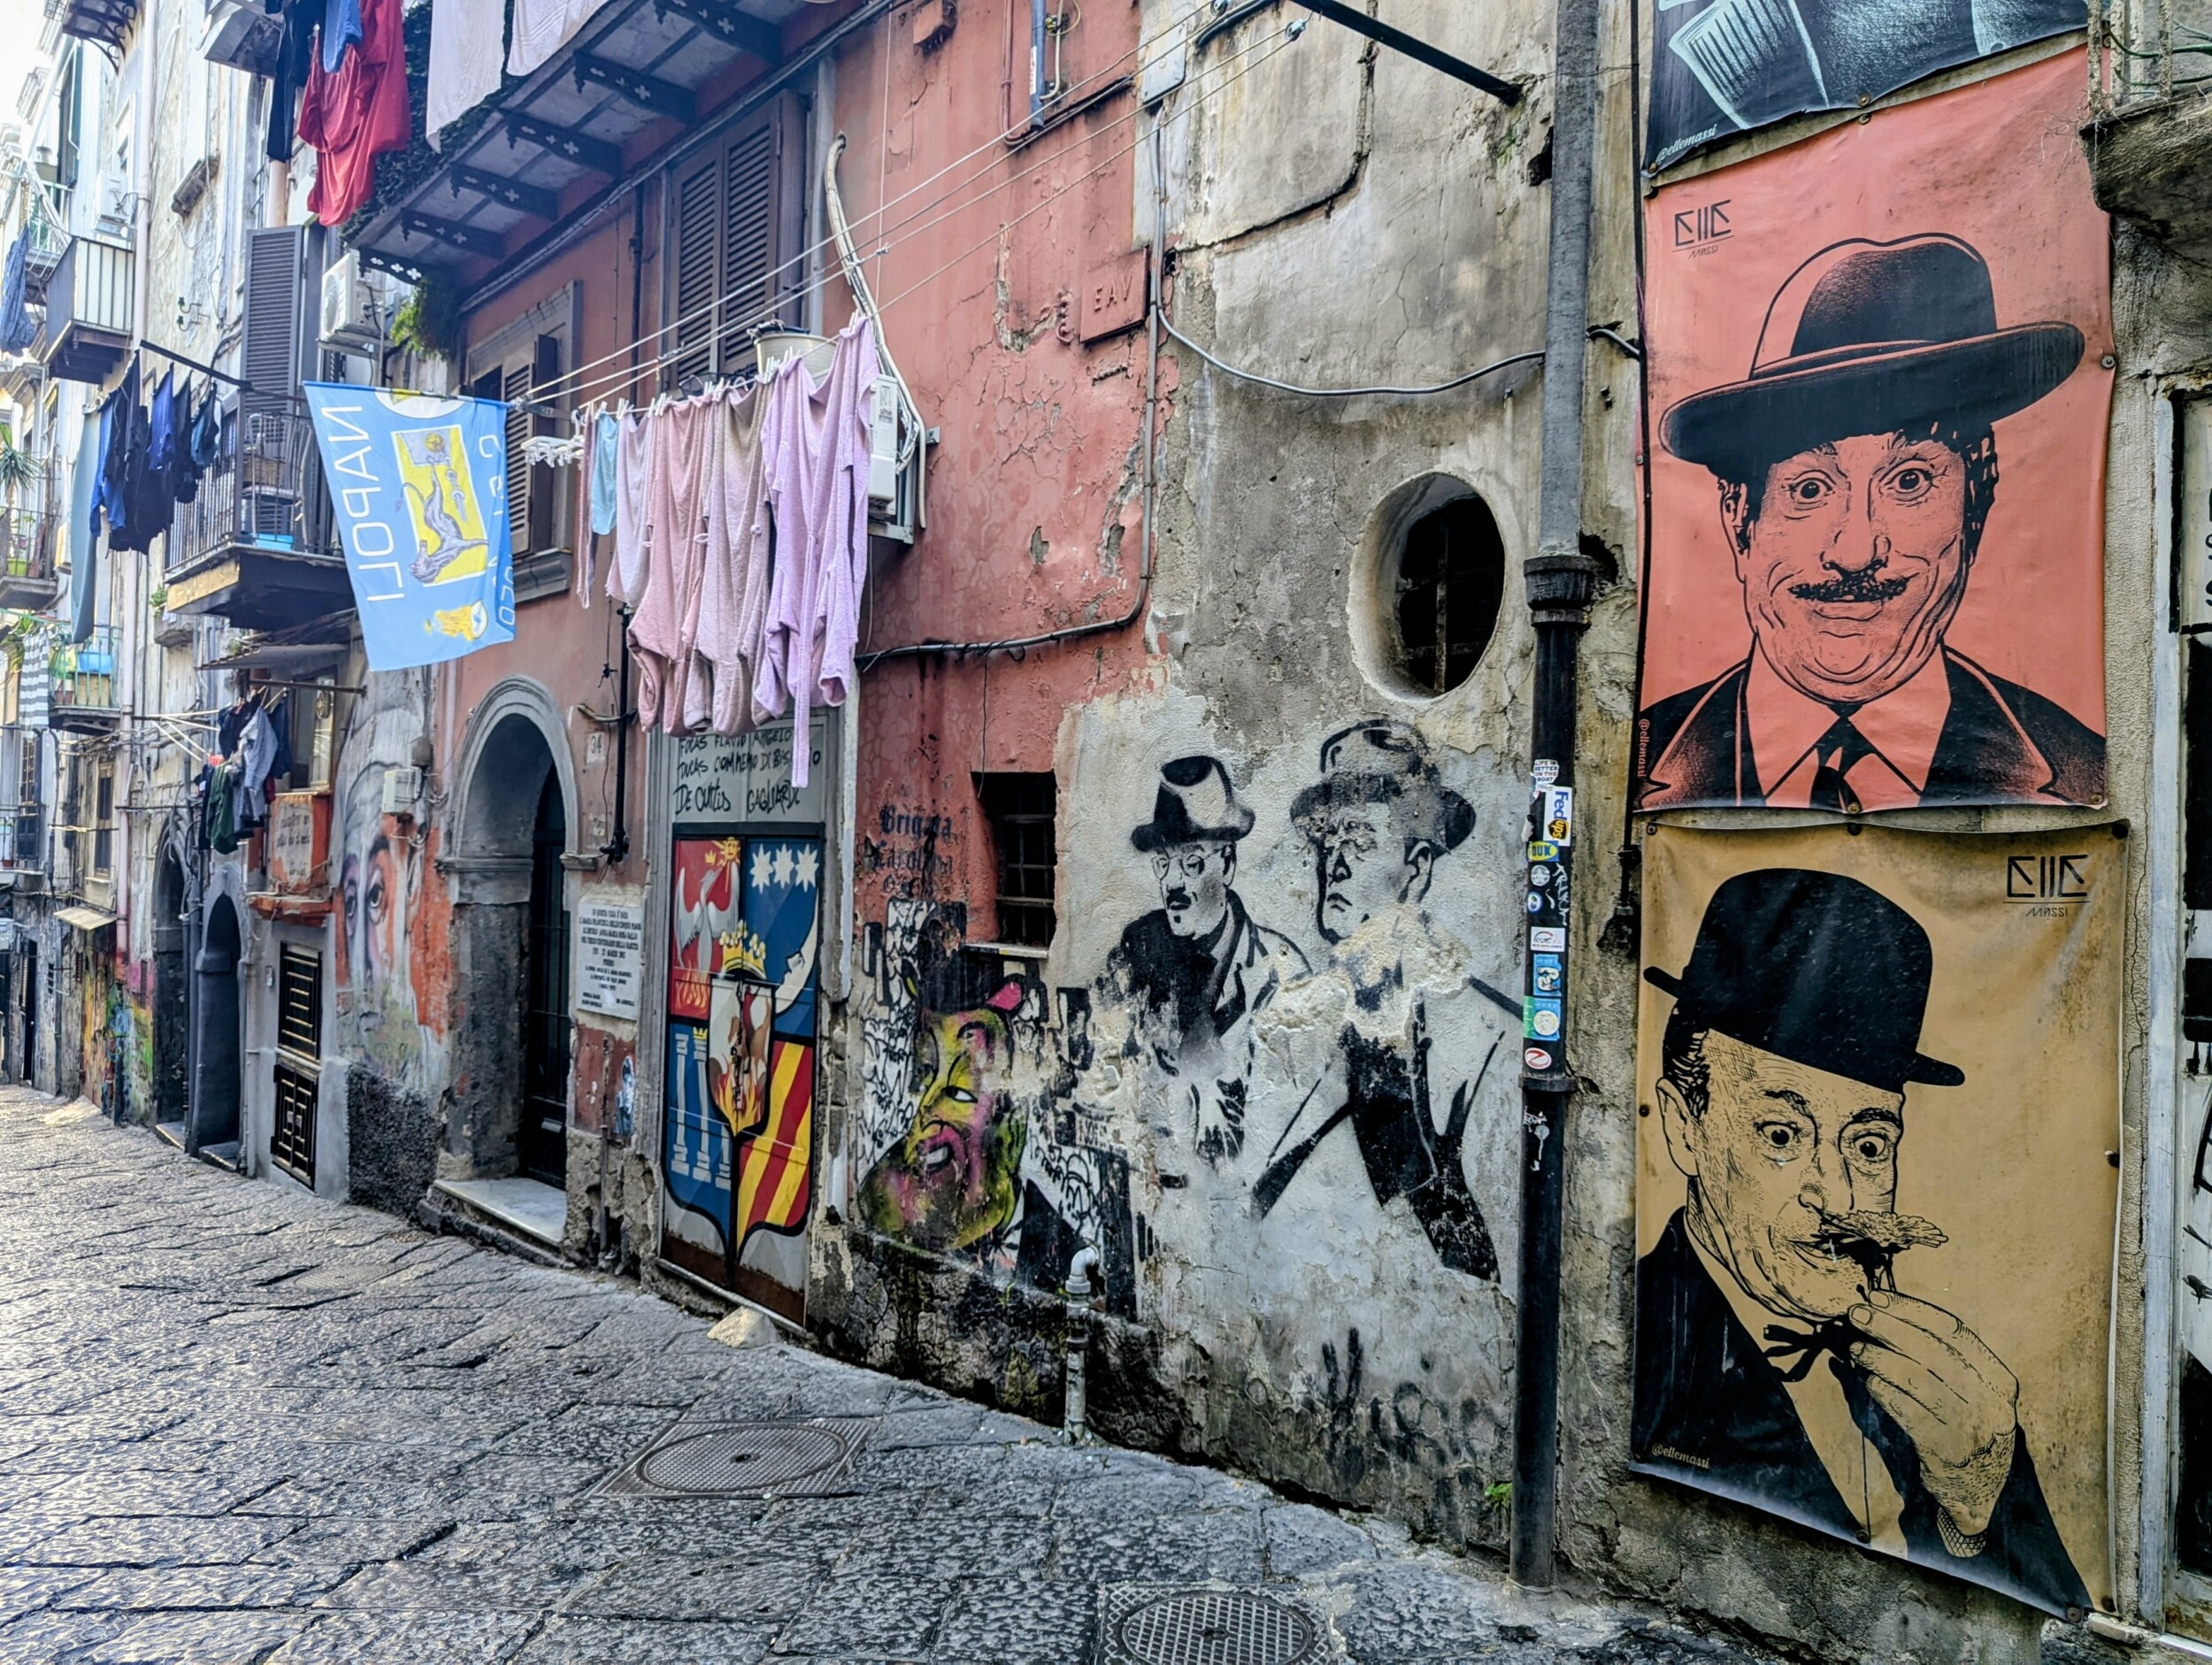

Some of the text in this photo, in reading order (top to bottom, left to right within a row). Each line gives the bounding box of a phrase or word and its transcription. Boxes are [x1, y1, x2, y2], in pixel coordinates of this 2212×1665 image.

[1656, 124, 1718, 165] @ellemassi
[1687, 245, 1718, 260] MASSI
[1094, 272, 1133, 313] EAV
[591, 733, 603, 754] 34
[1637, 718, 1650, 779] @ellemassi
[1551, 791, 1569, 839] Fed ups
[2025, 907, 2069, 917] MASSI
[1652, 1443, 1710, 1469] @ellemassi
